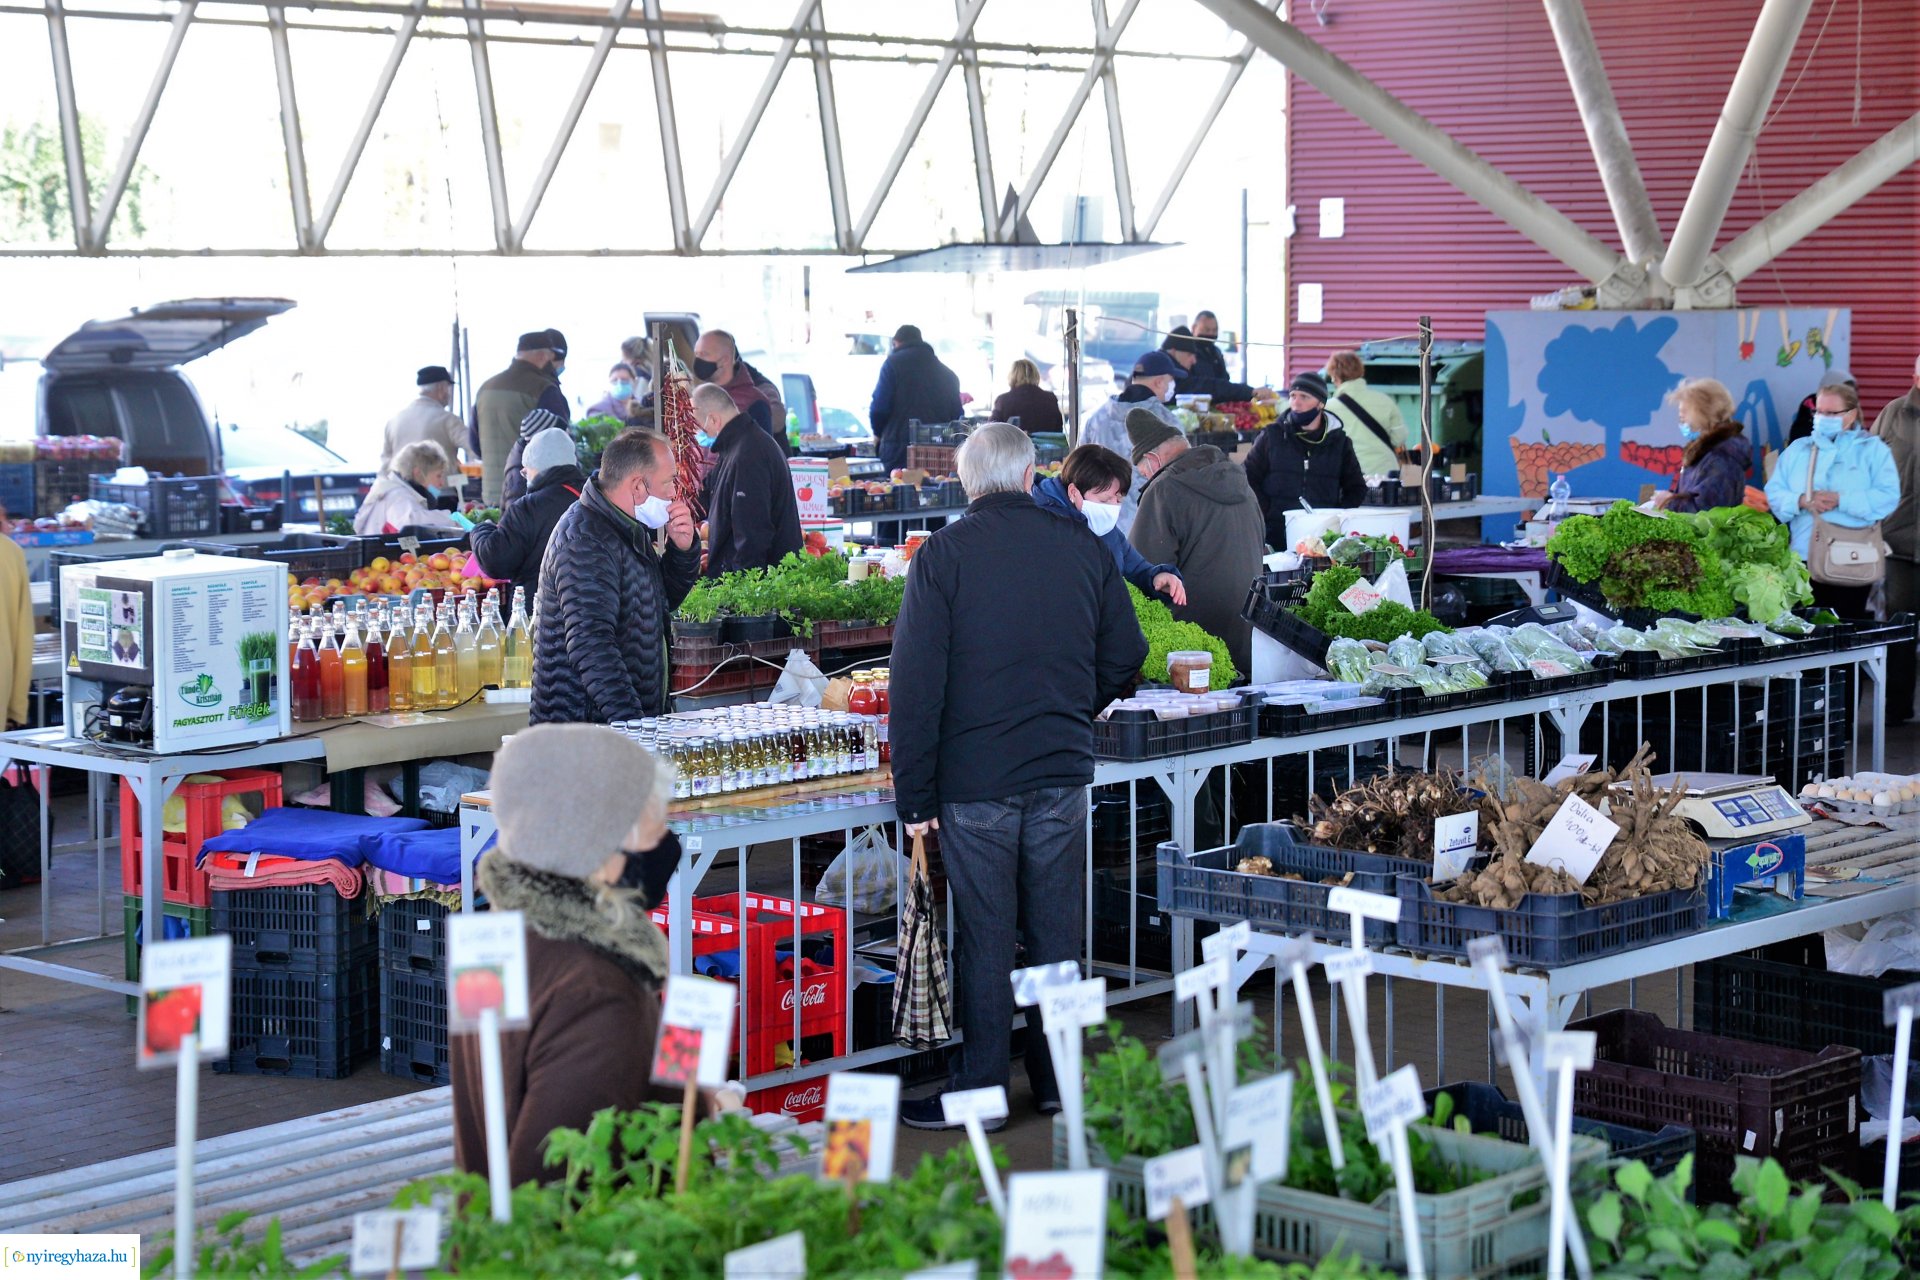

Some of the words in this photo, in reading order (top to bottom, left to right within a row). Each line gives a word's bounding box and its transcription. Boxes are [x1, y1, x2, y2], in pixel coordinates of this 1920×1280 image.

[172, 713, 224, 728] FAGYASZTOTT
[228, 701, 270, 721] Fűfélék
[784, 1086, 822, 1110] Coca-Cola
